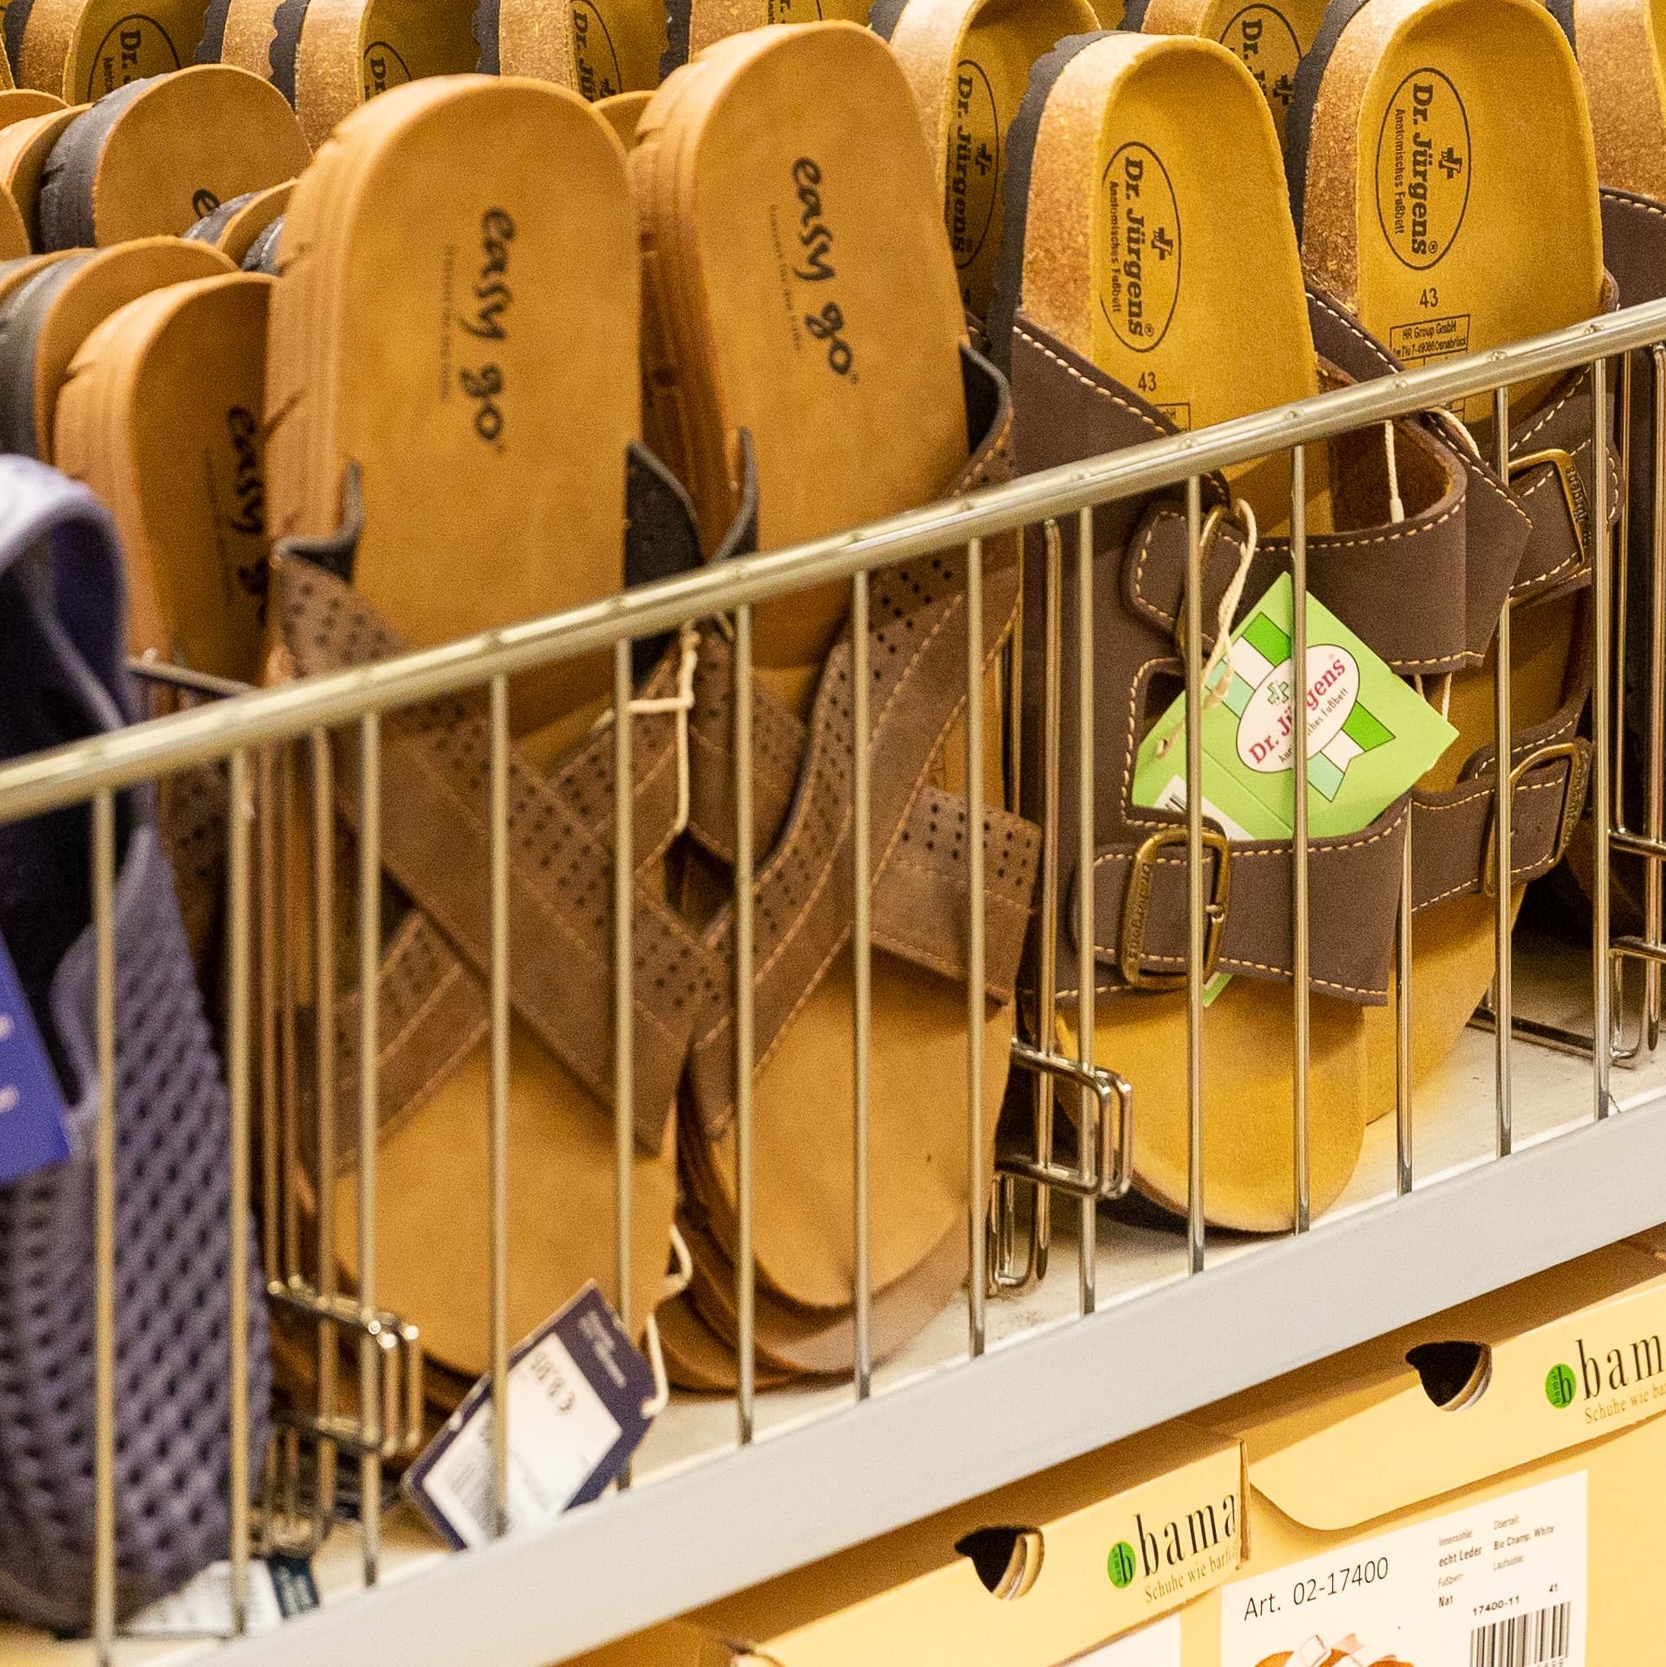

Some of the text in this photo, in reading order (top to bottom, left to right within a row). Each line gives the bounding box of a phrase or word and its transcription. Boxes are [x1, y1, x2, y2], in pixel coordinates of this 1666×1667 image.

[120, 29, 142, 71] Dr.
[952, 74, 974, 254] Dr. Jürgens
[1393, 108, 1406, 236] Anatomisches Fußbett
[1408, 83, 1434, 256] Dr. Jürgens
[792, 156, 853, 375] easy go
[1109, 181, 1122, 314] Anatomisches Fußbett
[1122, 155, 1145, 337] Dr. Jürgens
[458, 205, 517, 440] easy go
[1419, 287, 1439, 309] 43
[1414, 325, 1435, 340] Group
[1137, 371, 1158, 393] 43
[1248, 657, 1347, 765] Dr. Jügens
[1321, 686, 1350, 724] Fußbett
[1584, 1394, 1627, 1425] Schuhe
[1630, 1386, 1650, 1407] wie
[1134, 1493, 1237, 1577] bama
[1438, 1545, 1483, 1568] echt Leder
[1145, 1576, 1185, 1603] Schuhe
[1187, 1560, 1208, 1582] wie
[1244, 1556, 1389, 1622] Art. 02-17400
[1472, 1595, 1521, 1617] 17400-11
[1548, 1582, 1559, 1594] 41
